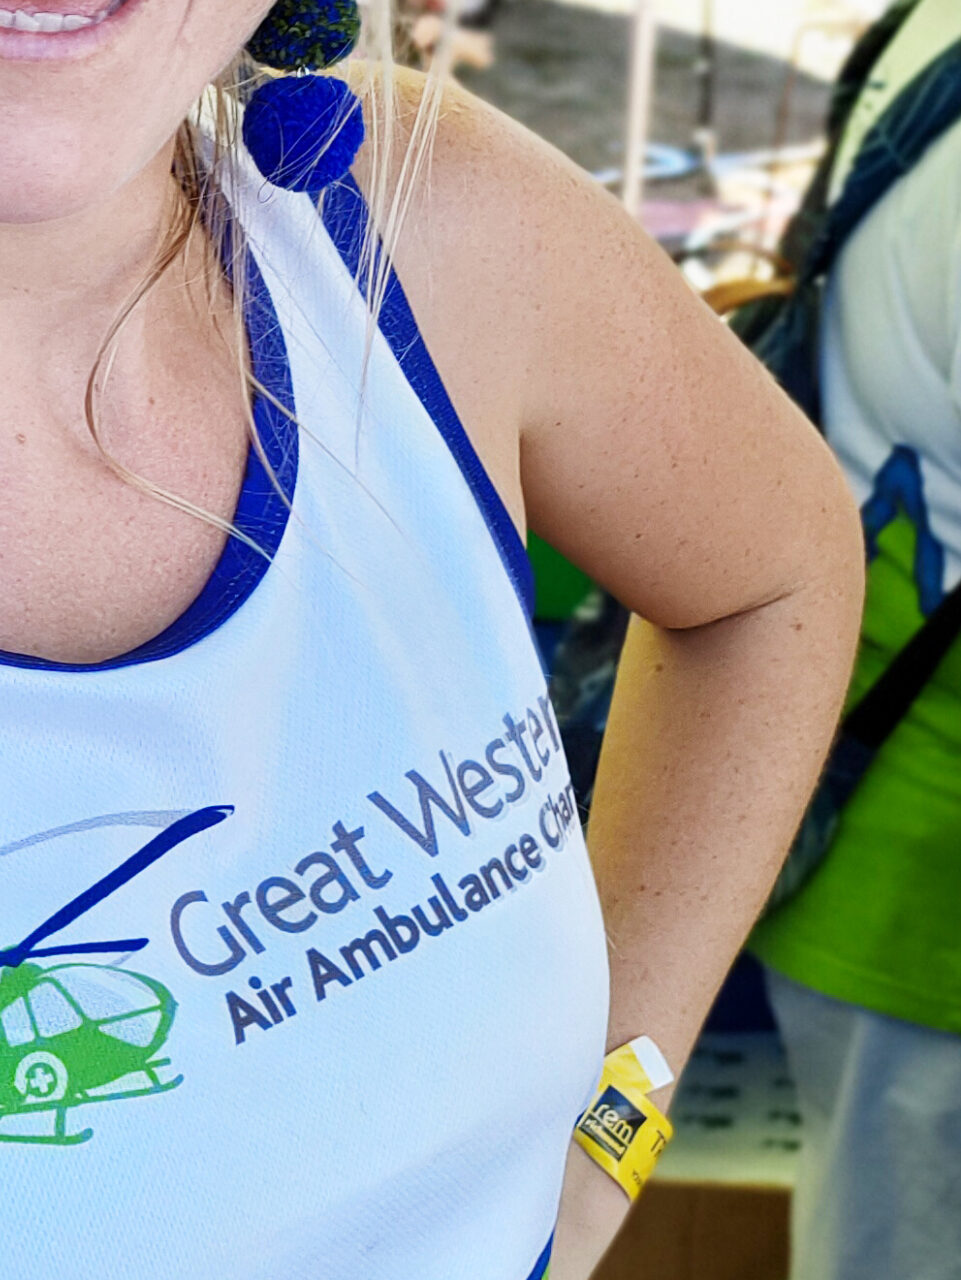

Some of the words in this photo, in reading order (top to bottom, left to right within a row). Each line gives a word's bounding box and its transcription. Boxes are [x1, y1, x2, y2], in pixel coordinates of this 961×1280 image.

[170, 819, 393, 976] Great
[367, 695, 560, 858] Wester
[225, 975, 297, 1045] Air
[305, 832, 542, 1002] Ambulance
[539, 782, 577, 849] Char
